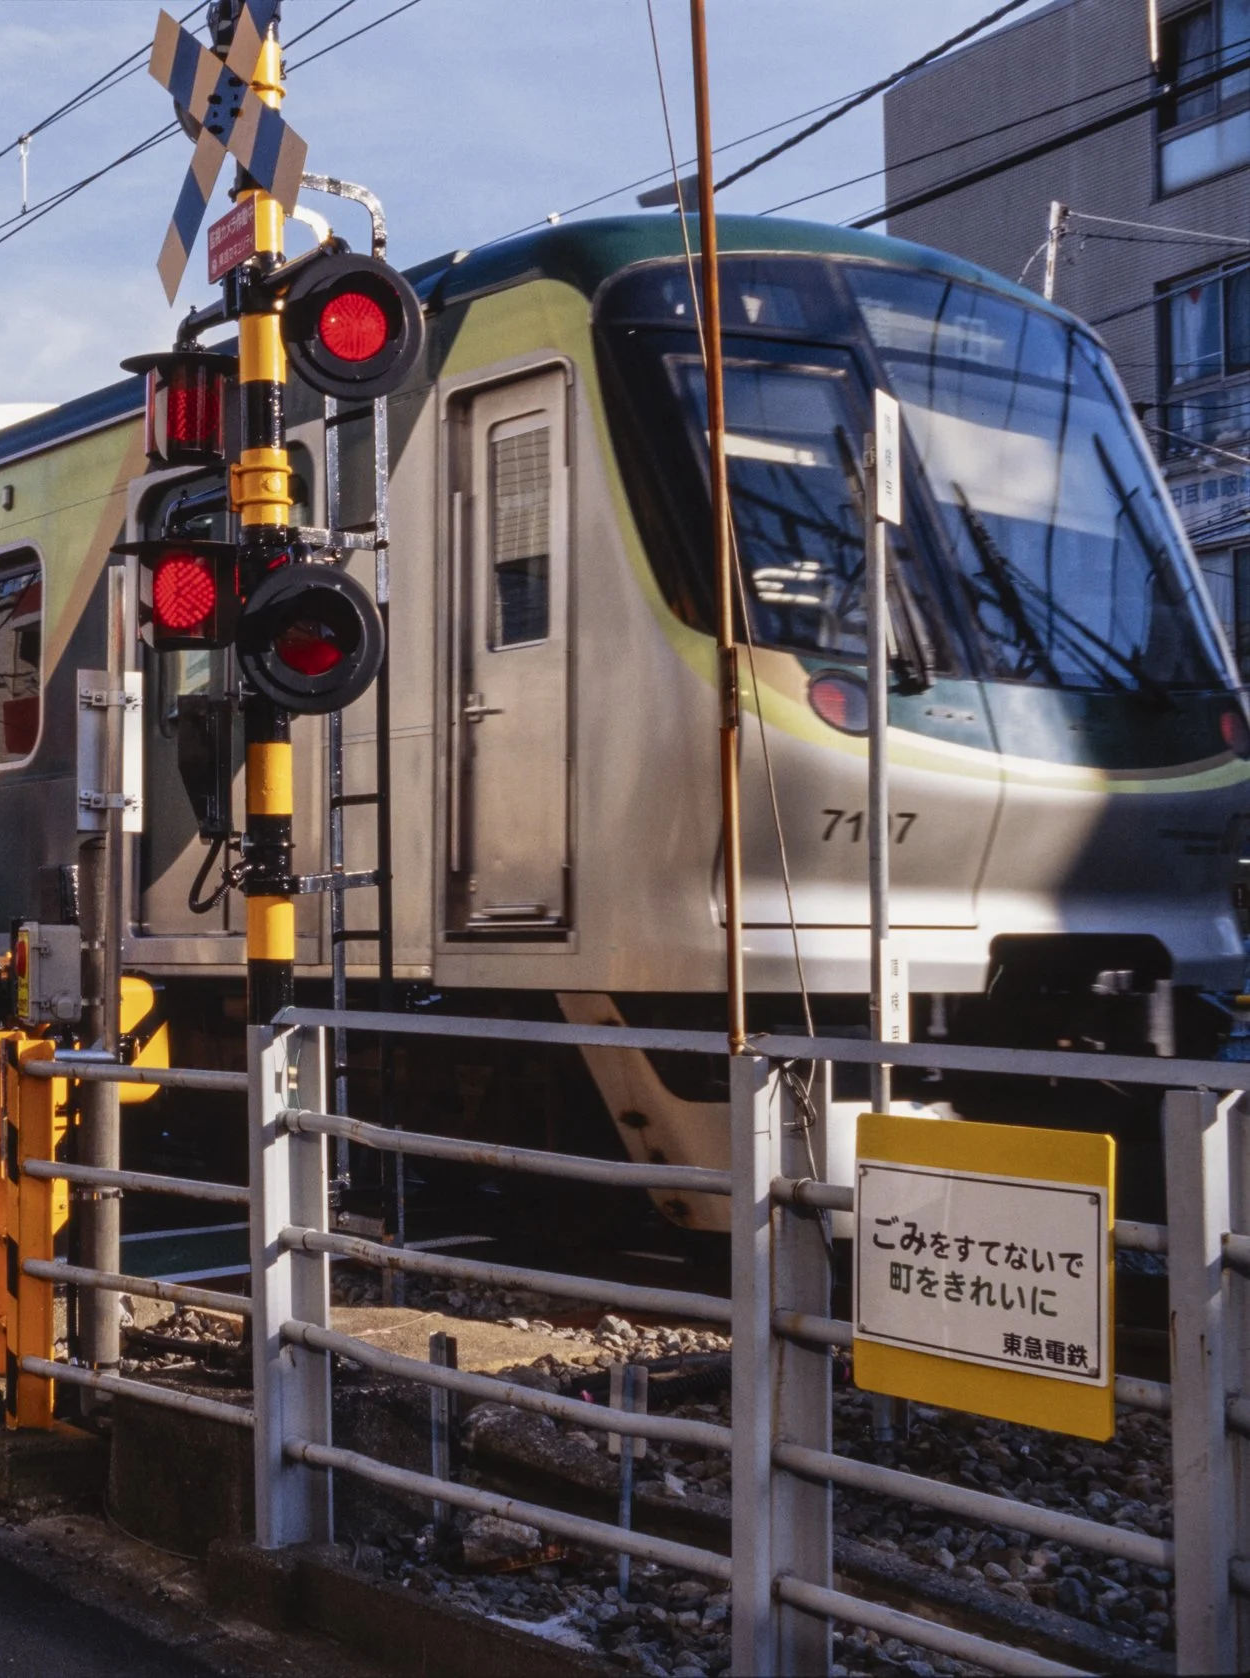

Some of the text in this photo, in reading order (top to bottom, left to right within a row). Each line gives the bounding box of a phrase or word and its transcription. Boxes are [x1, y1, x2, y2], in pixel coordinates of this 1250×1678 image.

[822, 809, 918, 844] 717
[873, 1215, 1083, 1278] ごみをすてないで
[890, 1262, 1058, 1316] 町をきれいに
[1003, 1332, 1089, 1369] 東急電鉄
